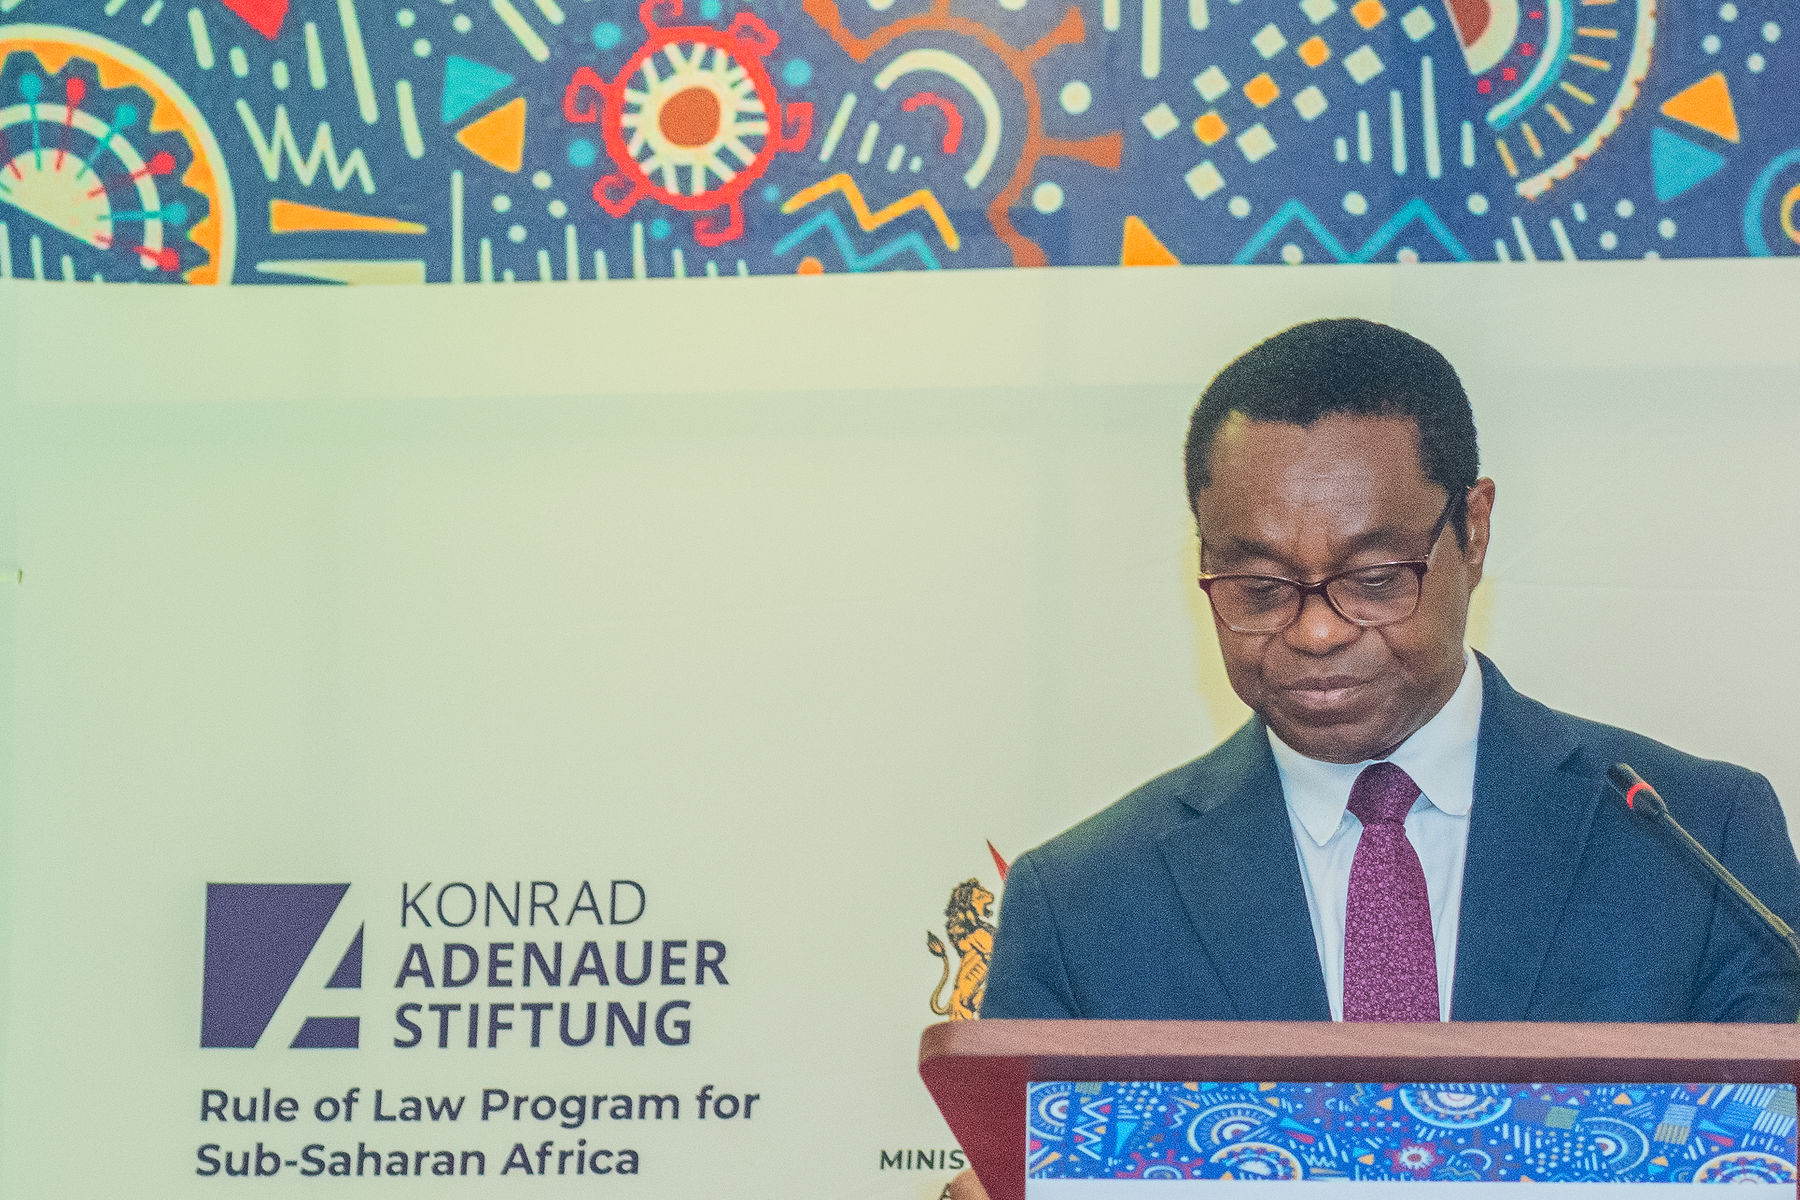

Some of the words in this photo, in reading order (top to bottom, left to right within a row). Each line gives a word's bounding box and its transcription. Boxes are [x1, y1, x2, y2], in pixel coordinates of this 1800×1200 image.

[401, 880, 646, 927] KONRAD
[395, 940, 728, 988] ADENAUER
[394, 1000, 690, 1048] STIFTUNG
[201, 1088, 299, 1122] Rule
[314, 1088, 360, 1122] of
[374, 1090, 465, 1121] Law
[482, 1089, 679, 1129] Program
[696, 1085, 760, 1119] for
[196, 1143, 485, 1177] Sub-Saharan
[501, 1139, 639, 1175] Africa
